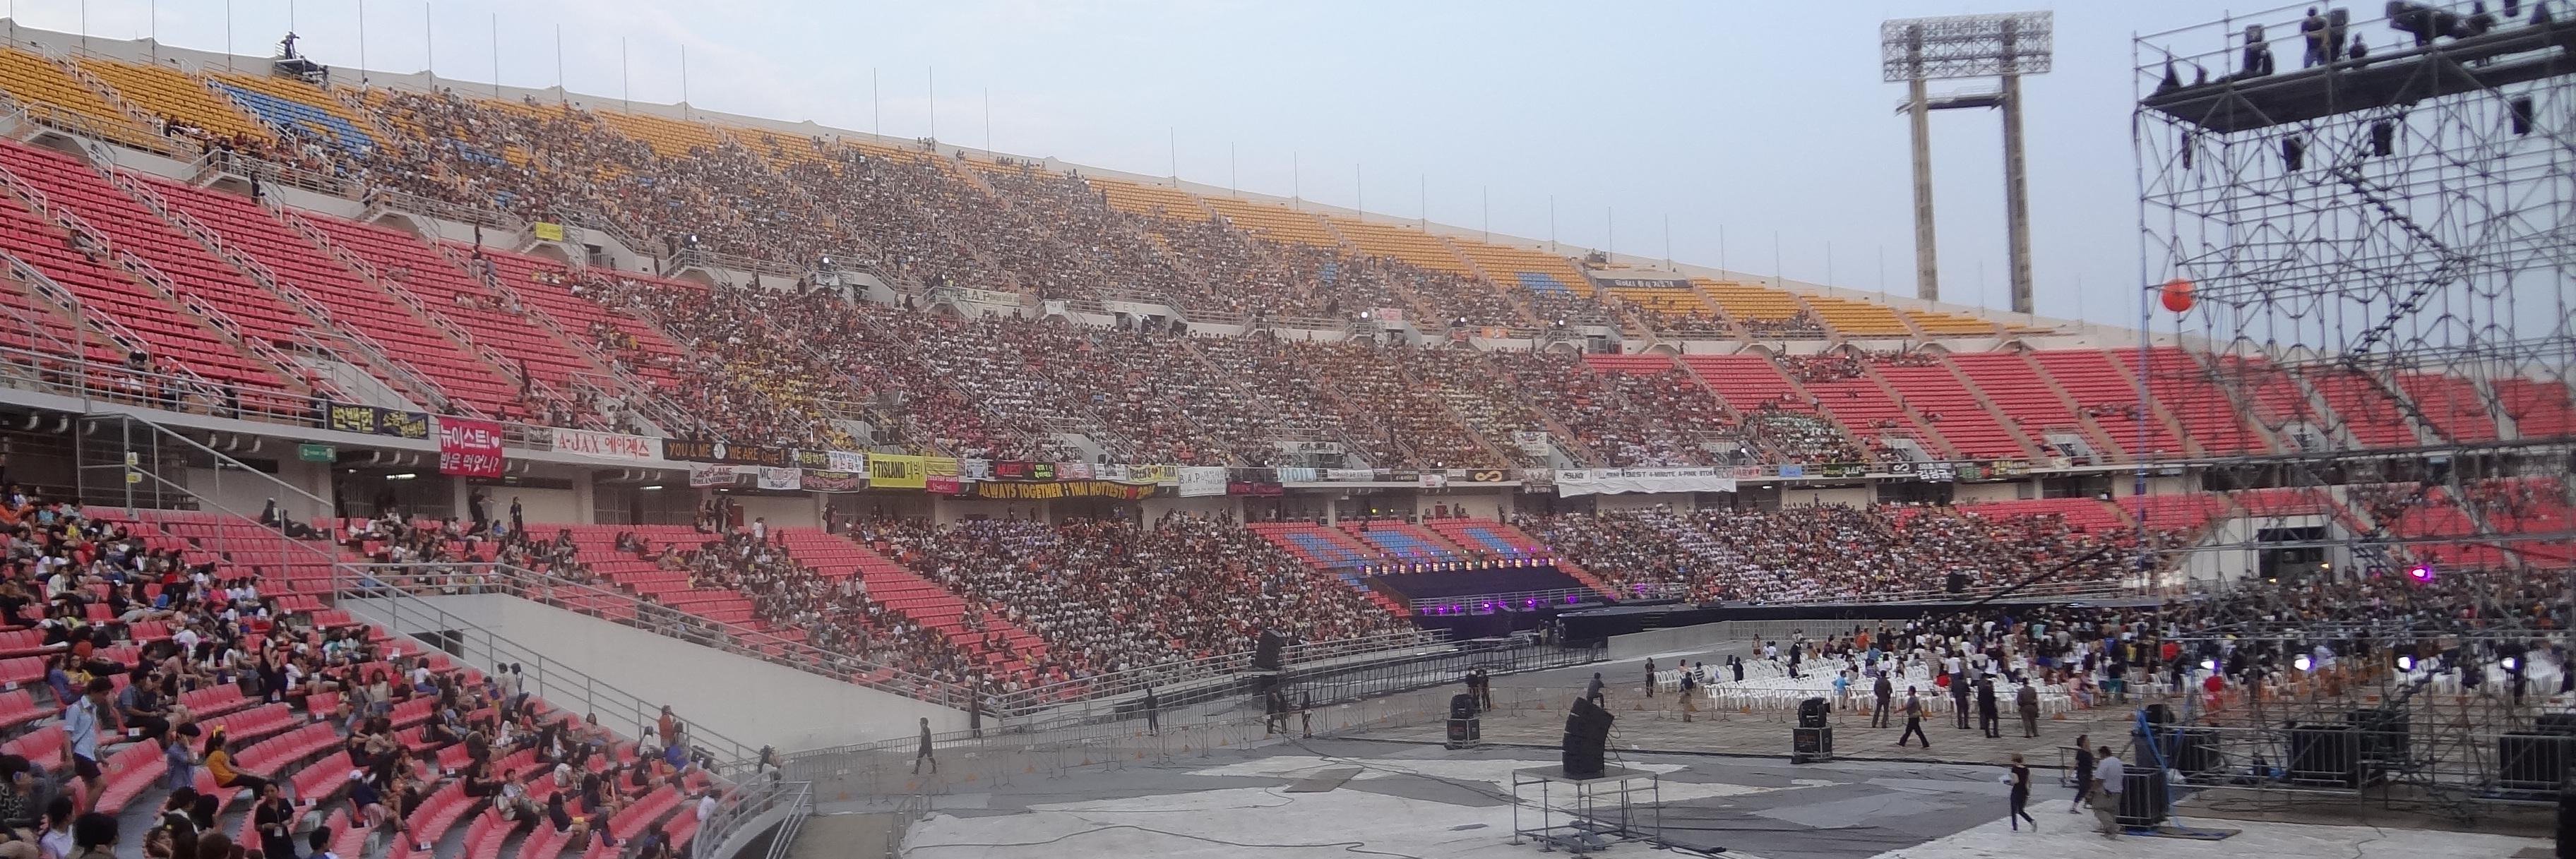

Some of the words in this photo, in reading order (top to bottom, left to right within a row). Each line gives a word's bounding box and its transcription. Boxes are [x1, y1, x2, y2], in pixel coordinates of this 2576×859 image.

[559, 432, 600, 453] A-JAX
[669, 443, 688, 457] YOU
[689, 443, 697, 457] &
[698, 443, 711, 458] ME
[728, 445, 741, 459] WE
[742, 447, 758, 461] ARE
[872, 460, 905, 479] FTISLAND
[1179, 472, 1200, 484] B.A.P
[979, 482, 1017, 499] ALWAYS
[1018, 483, 1063, 499] TOGETHER
[1069, 481, 1088, 497] THAI
[1090, 481, 1128, 500] HOTTESTS
